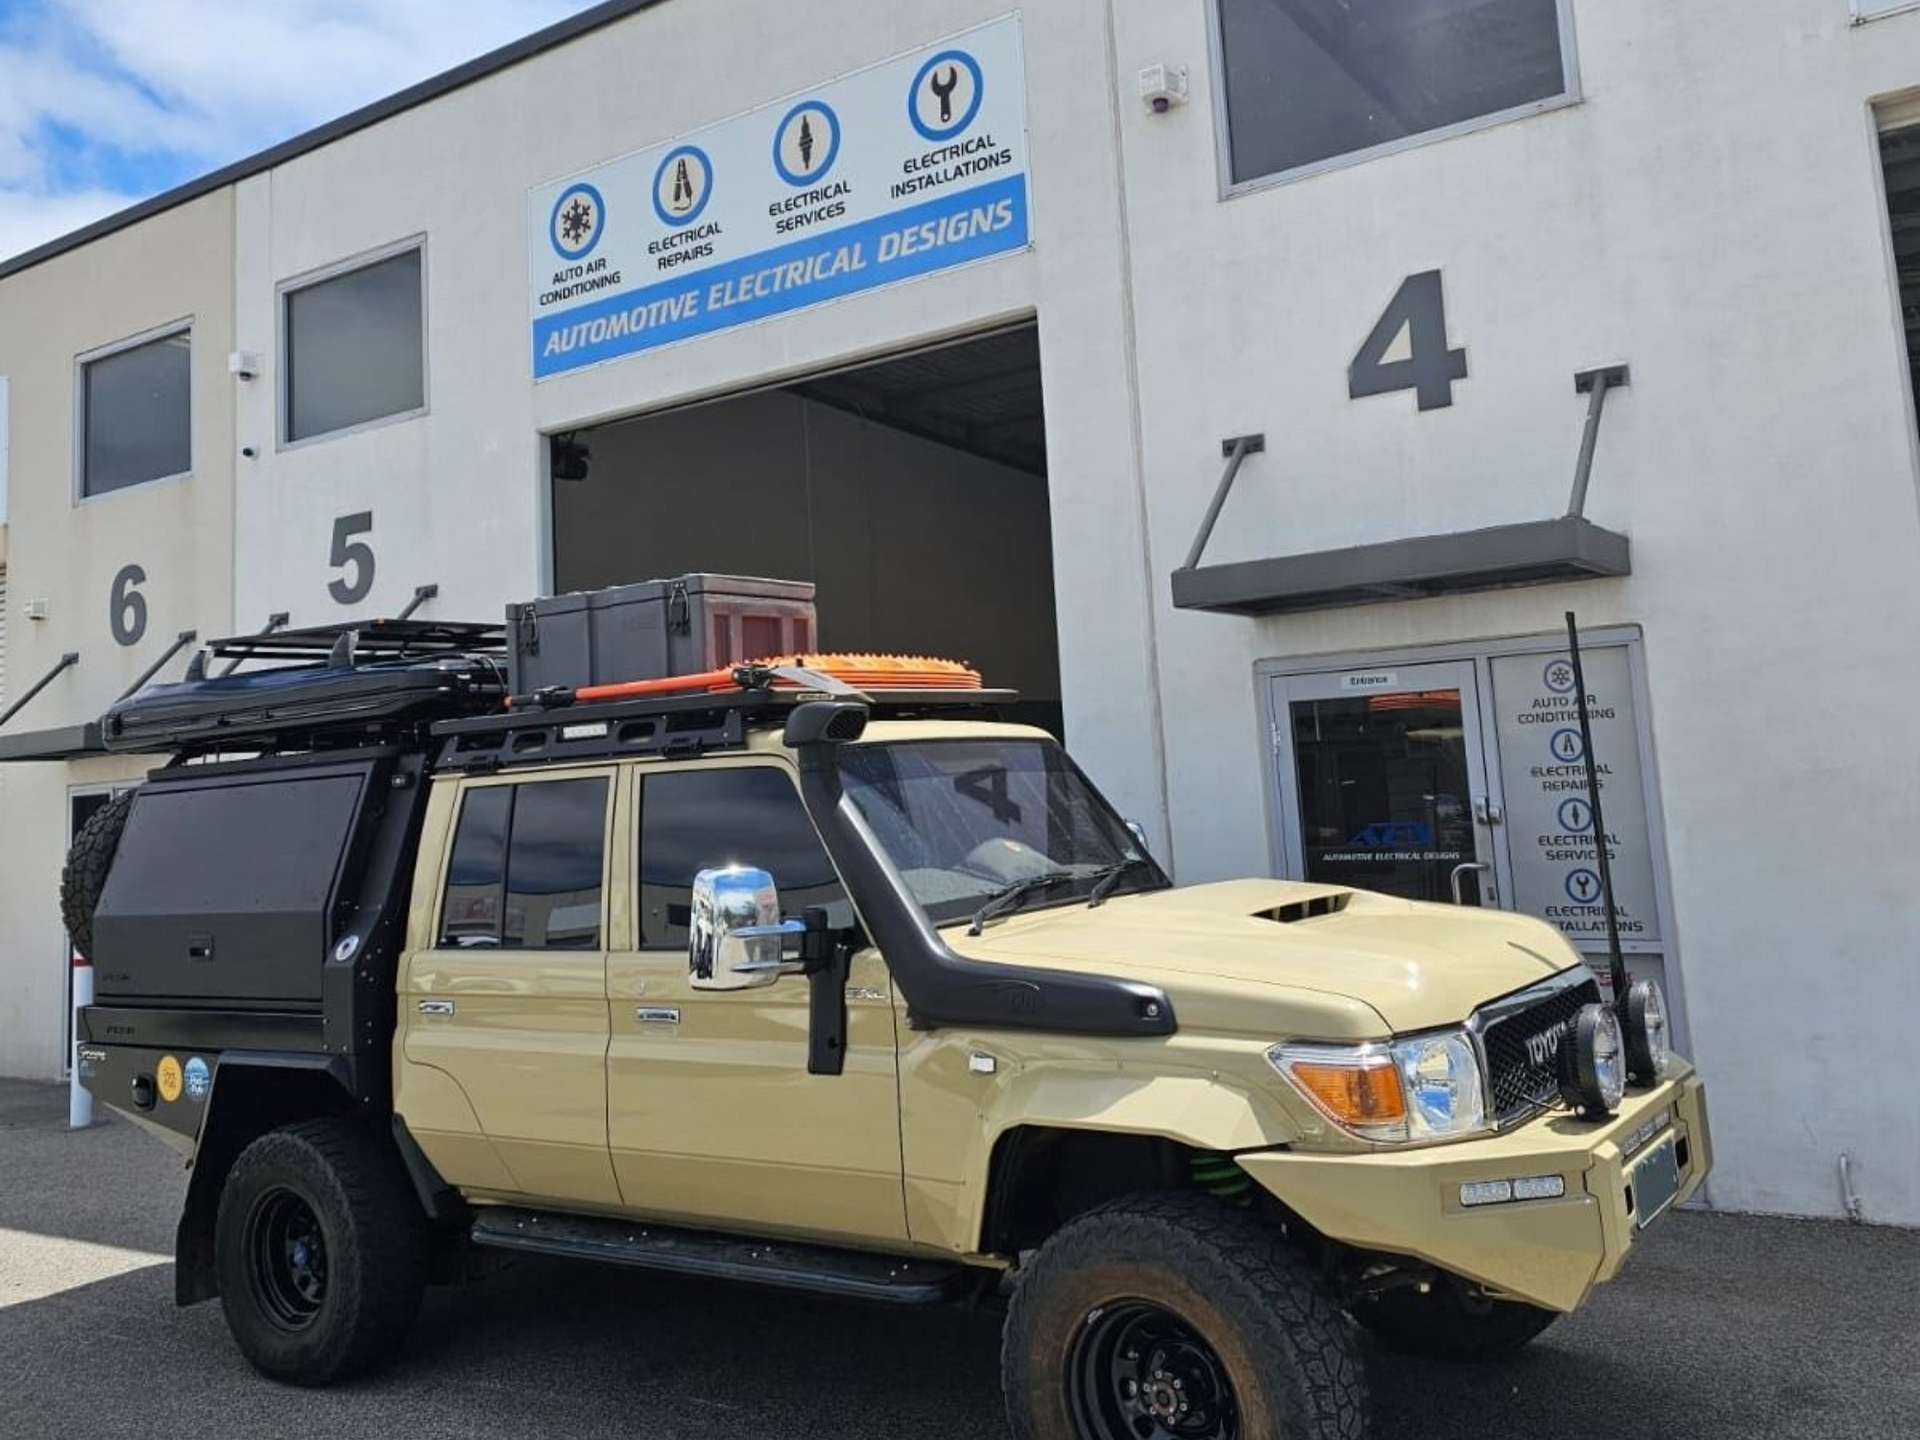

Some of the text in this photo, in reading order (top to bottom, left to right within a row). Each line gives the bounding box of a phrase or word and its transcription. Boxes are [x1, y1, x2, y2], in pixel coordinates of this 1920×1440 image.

[904, 135, 996, 174] ELECTRICAL
[890, 149, 1012, 199] INSTALLATIONS
[769, 180, 851, 216] ELECTRICAL
[776, 201, 846, 234] SERVICES
[648, 221, 722, 255] ELECTRICAL
[553, 258, 607, 284] AUTO AIR
[658, 242, 713, 270] REPAIRS
[539, 271, 621, 306] CONDITIONING
[544, 199, 1012, 356] AUTOMOTIVE ELECTRICAL DESIGNS
[1348, 269, 1467, 411] 4
[328, 511, 375, 605] 5
[110, 564, 147, 646] 6
[1532, 696, 1569, 709] AUTO
[1545, 849, 1616, 862] SERVICS
